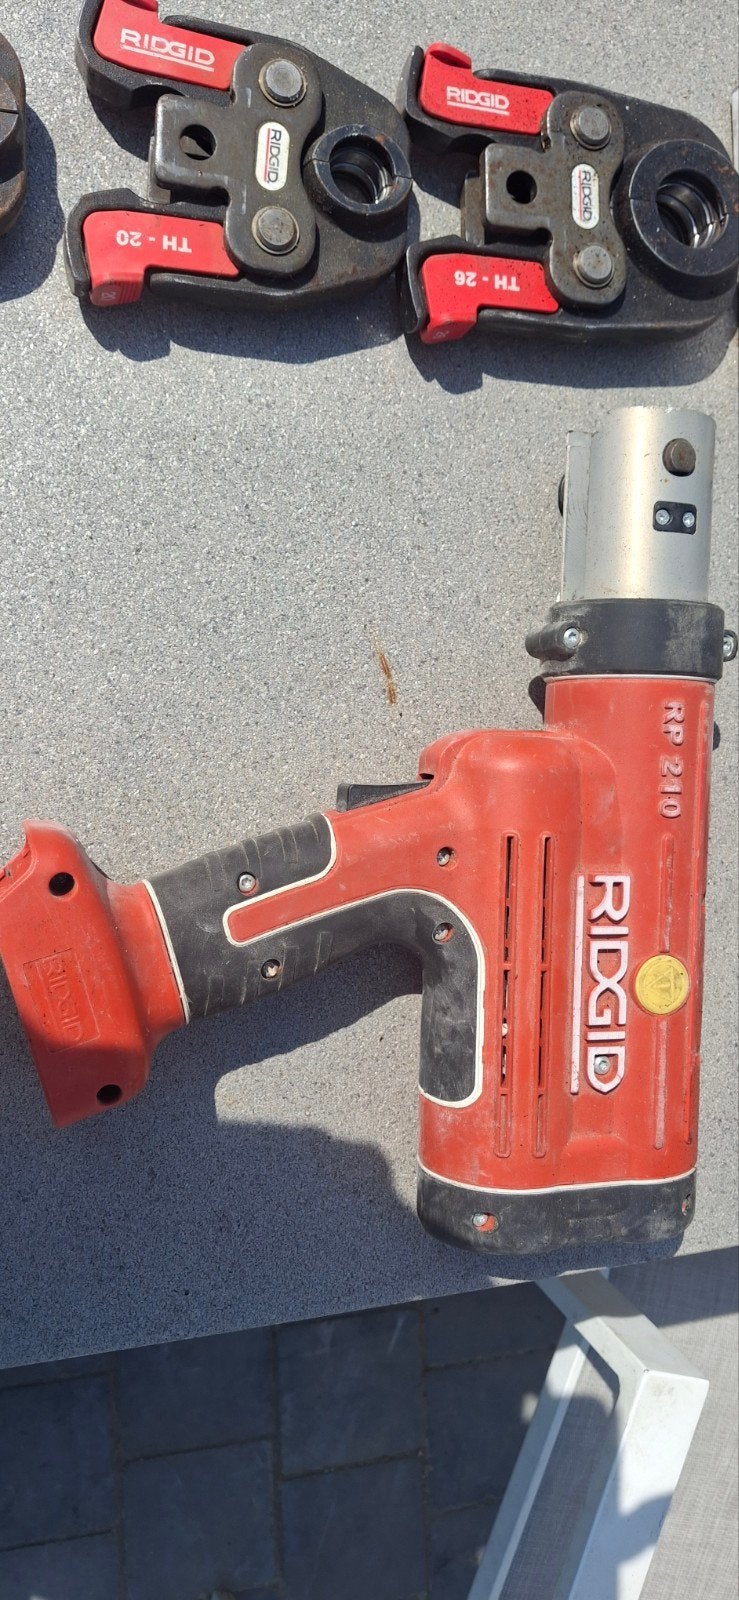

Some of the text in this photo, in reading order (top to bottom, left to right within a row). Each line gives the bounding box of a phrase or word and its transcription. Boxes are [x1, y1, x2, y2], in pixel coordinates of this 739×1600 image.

[120, 27, 216, 66] RIDGID
[446, 86, 510, 109] RIDGID
[269, 128, 283, 184] RIDGID
[581, 170, 593, 223] RIDGID
[116, 229, 142, 245] 20
[162, 236, 192, 253] TH
[454, 270, 477, 287] 26
[494, 276, 521, 291] TH
[659, 702, 685, 819] RP 210
[43, 958, 82, 1041] RIDGID
[585, 874, 632, 1095] RIDGID
